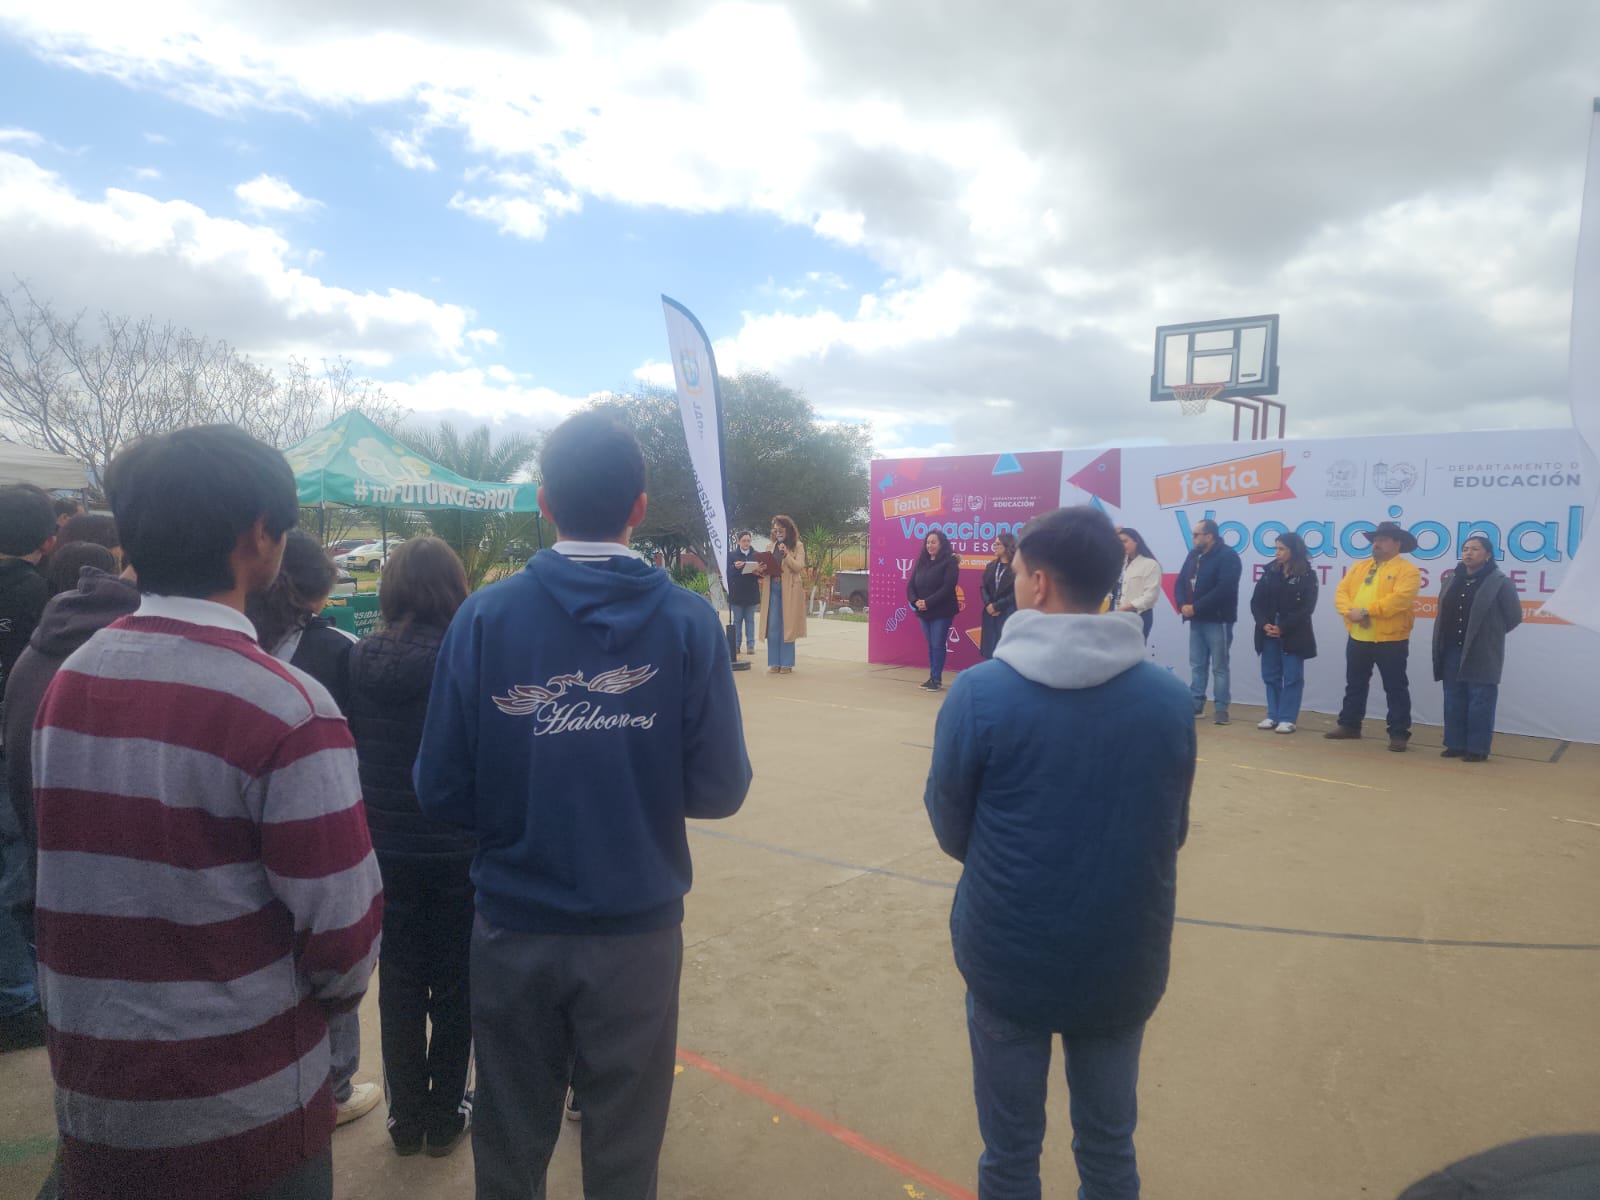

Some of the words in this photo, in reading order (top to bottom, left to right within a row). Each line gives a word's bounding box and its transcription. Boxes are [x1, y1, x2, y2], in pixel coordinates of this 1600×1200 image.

[1448, 462, 1561, 472] DEPARTAMENTO
[1569, 462, 1580, 471] D
[1180, 466, 1260, 501] feria
[1453, 471, 1581, 488] EDUCACIÓN
[894, 496, 930, 516] feria
[900, 515, 1027, 540] Voacion
[533, 700, 657, 736] Halcones
